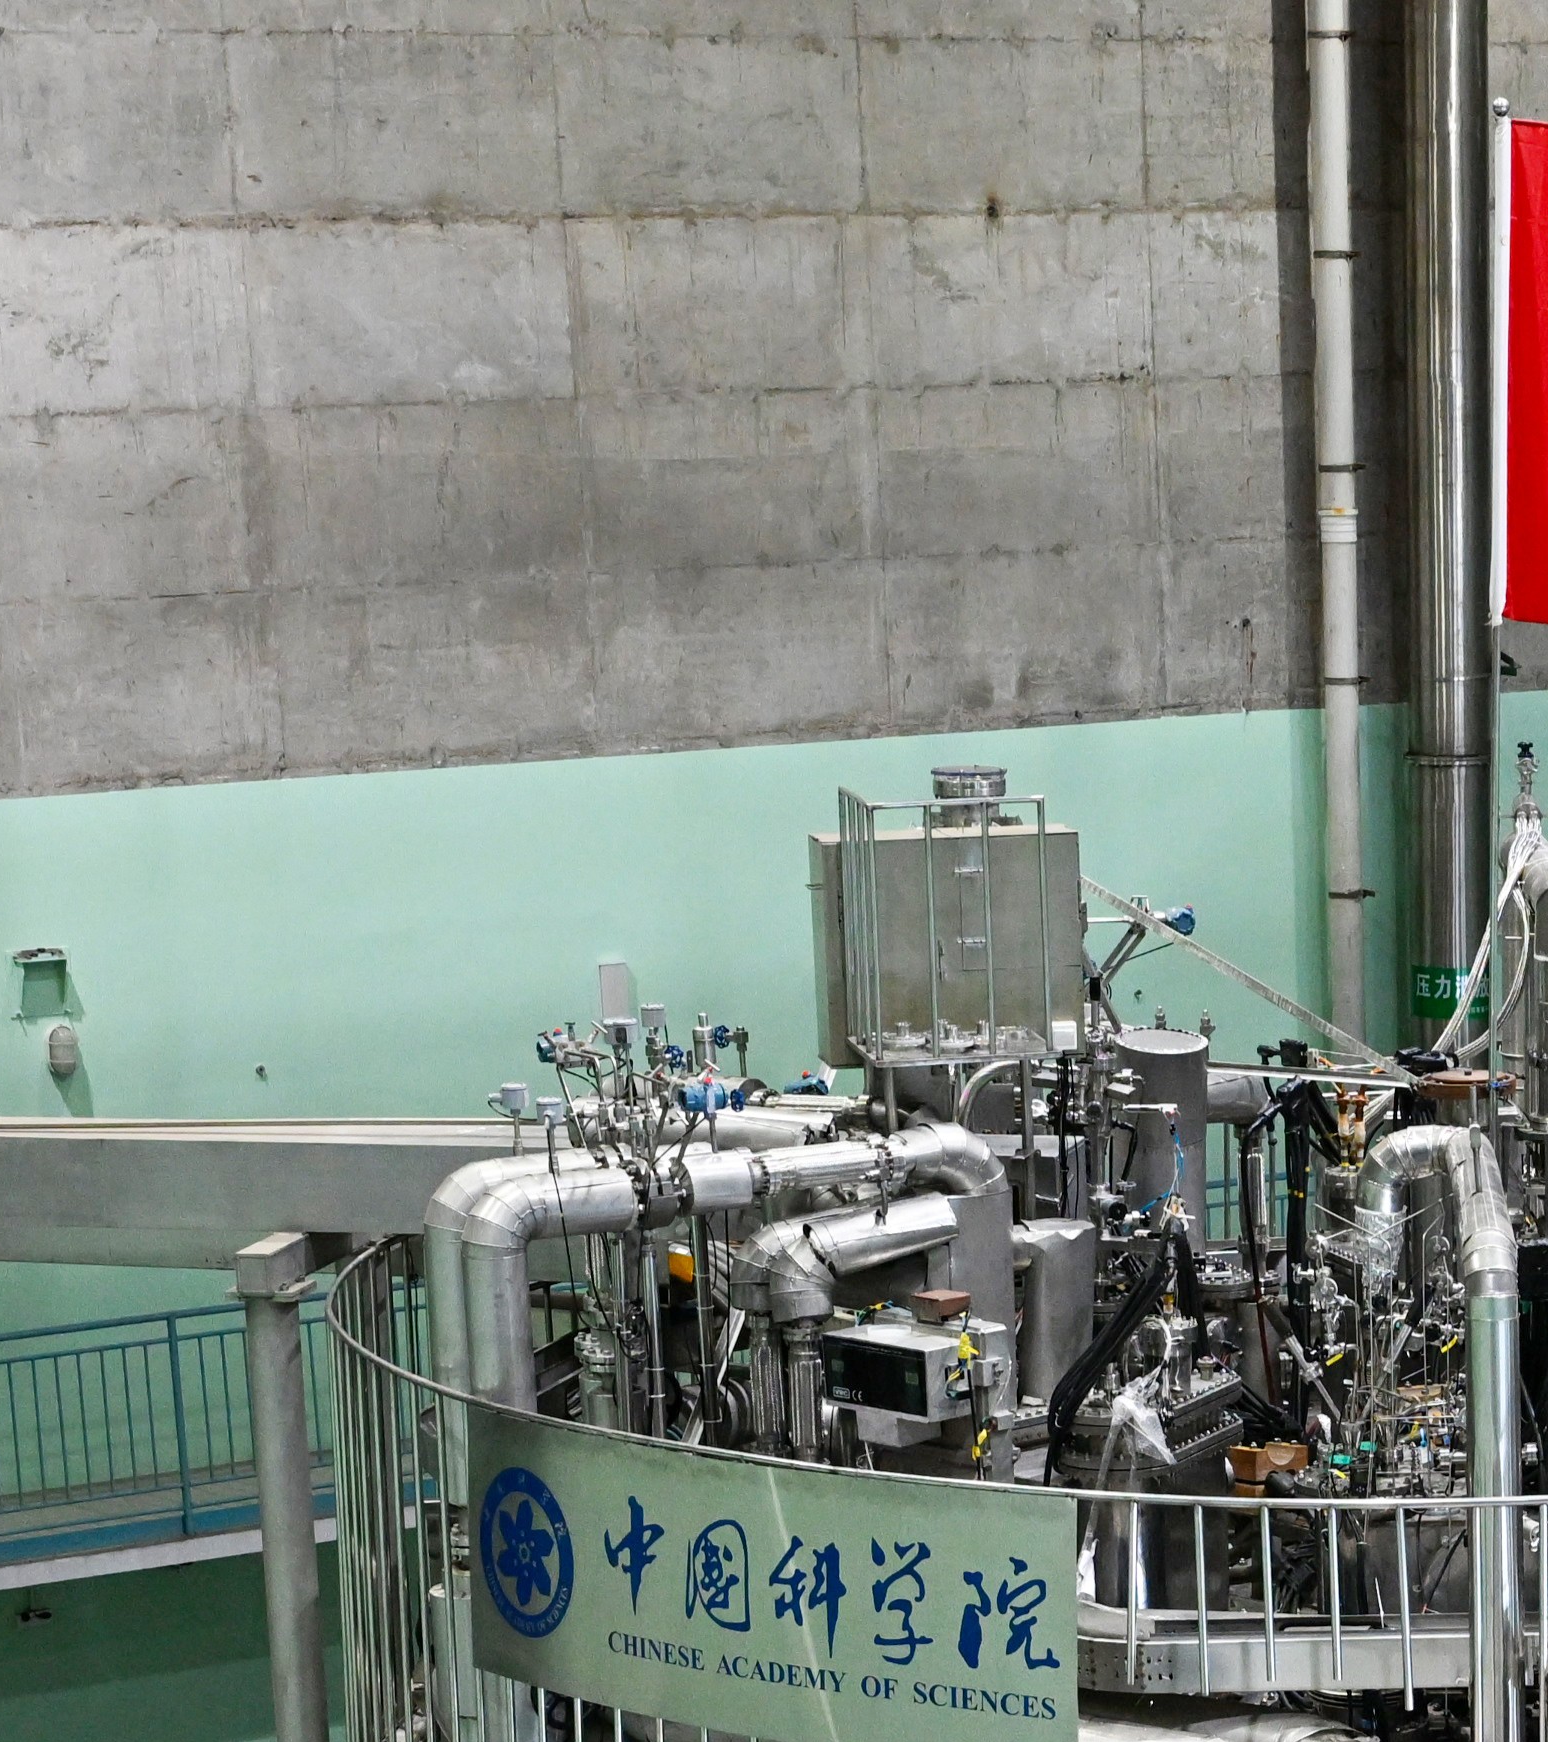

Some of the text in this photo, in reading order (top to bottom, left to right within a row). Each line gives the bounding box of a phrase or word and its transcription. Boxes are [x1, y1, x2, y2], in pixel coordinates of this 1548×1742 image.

[608, 1631, 1056, 1720] CHINESE ACADEMY OF SCIENCES
